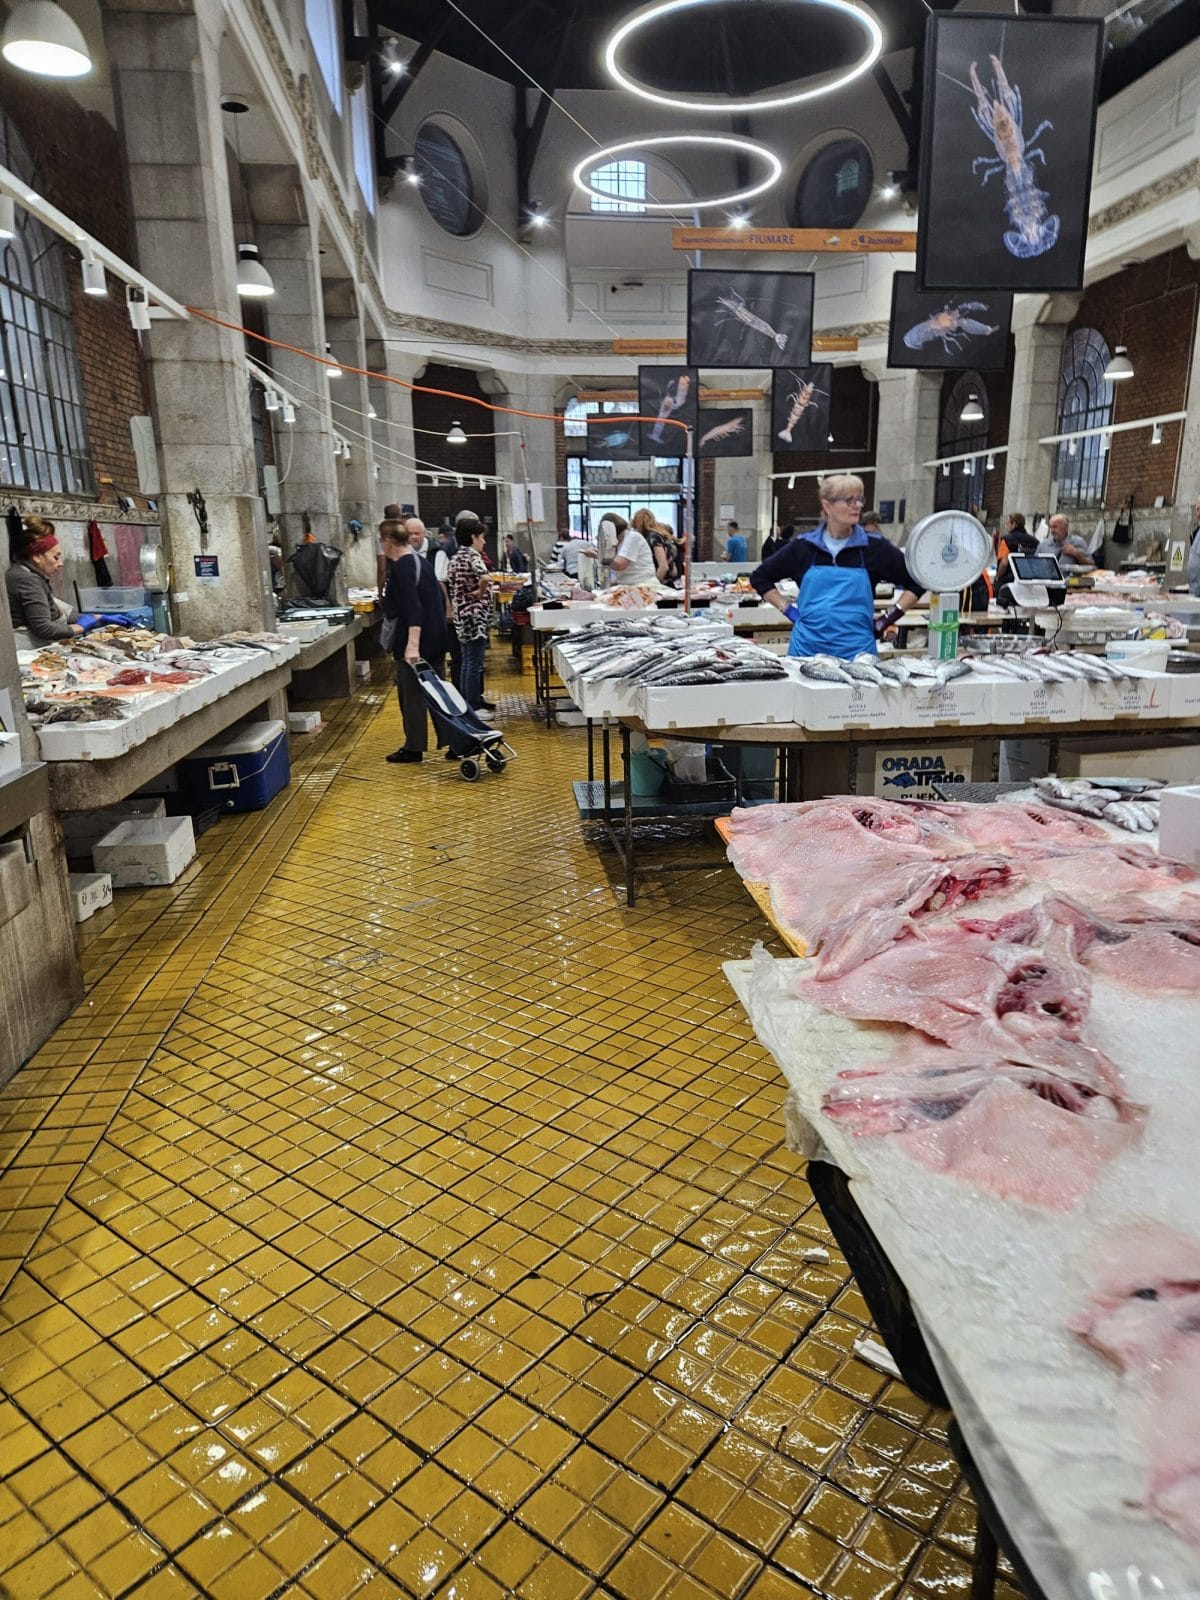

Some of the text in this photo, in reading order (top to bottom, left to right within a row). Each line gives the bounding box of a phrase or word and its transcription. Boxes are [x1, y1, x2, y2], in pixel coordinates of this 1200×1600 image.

[748, 234, 795, 246] FIUMARE
[882, 755, 946, 772] ORADA
[914, 769, 965, 787] Trade
